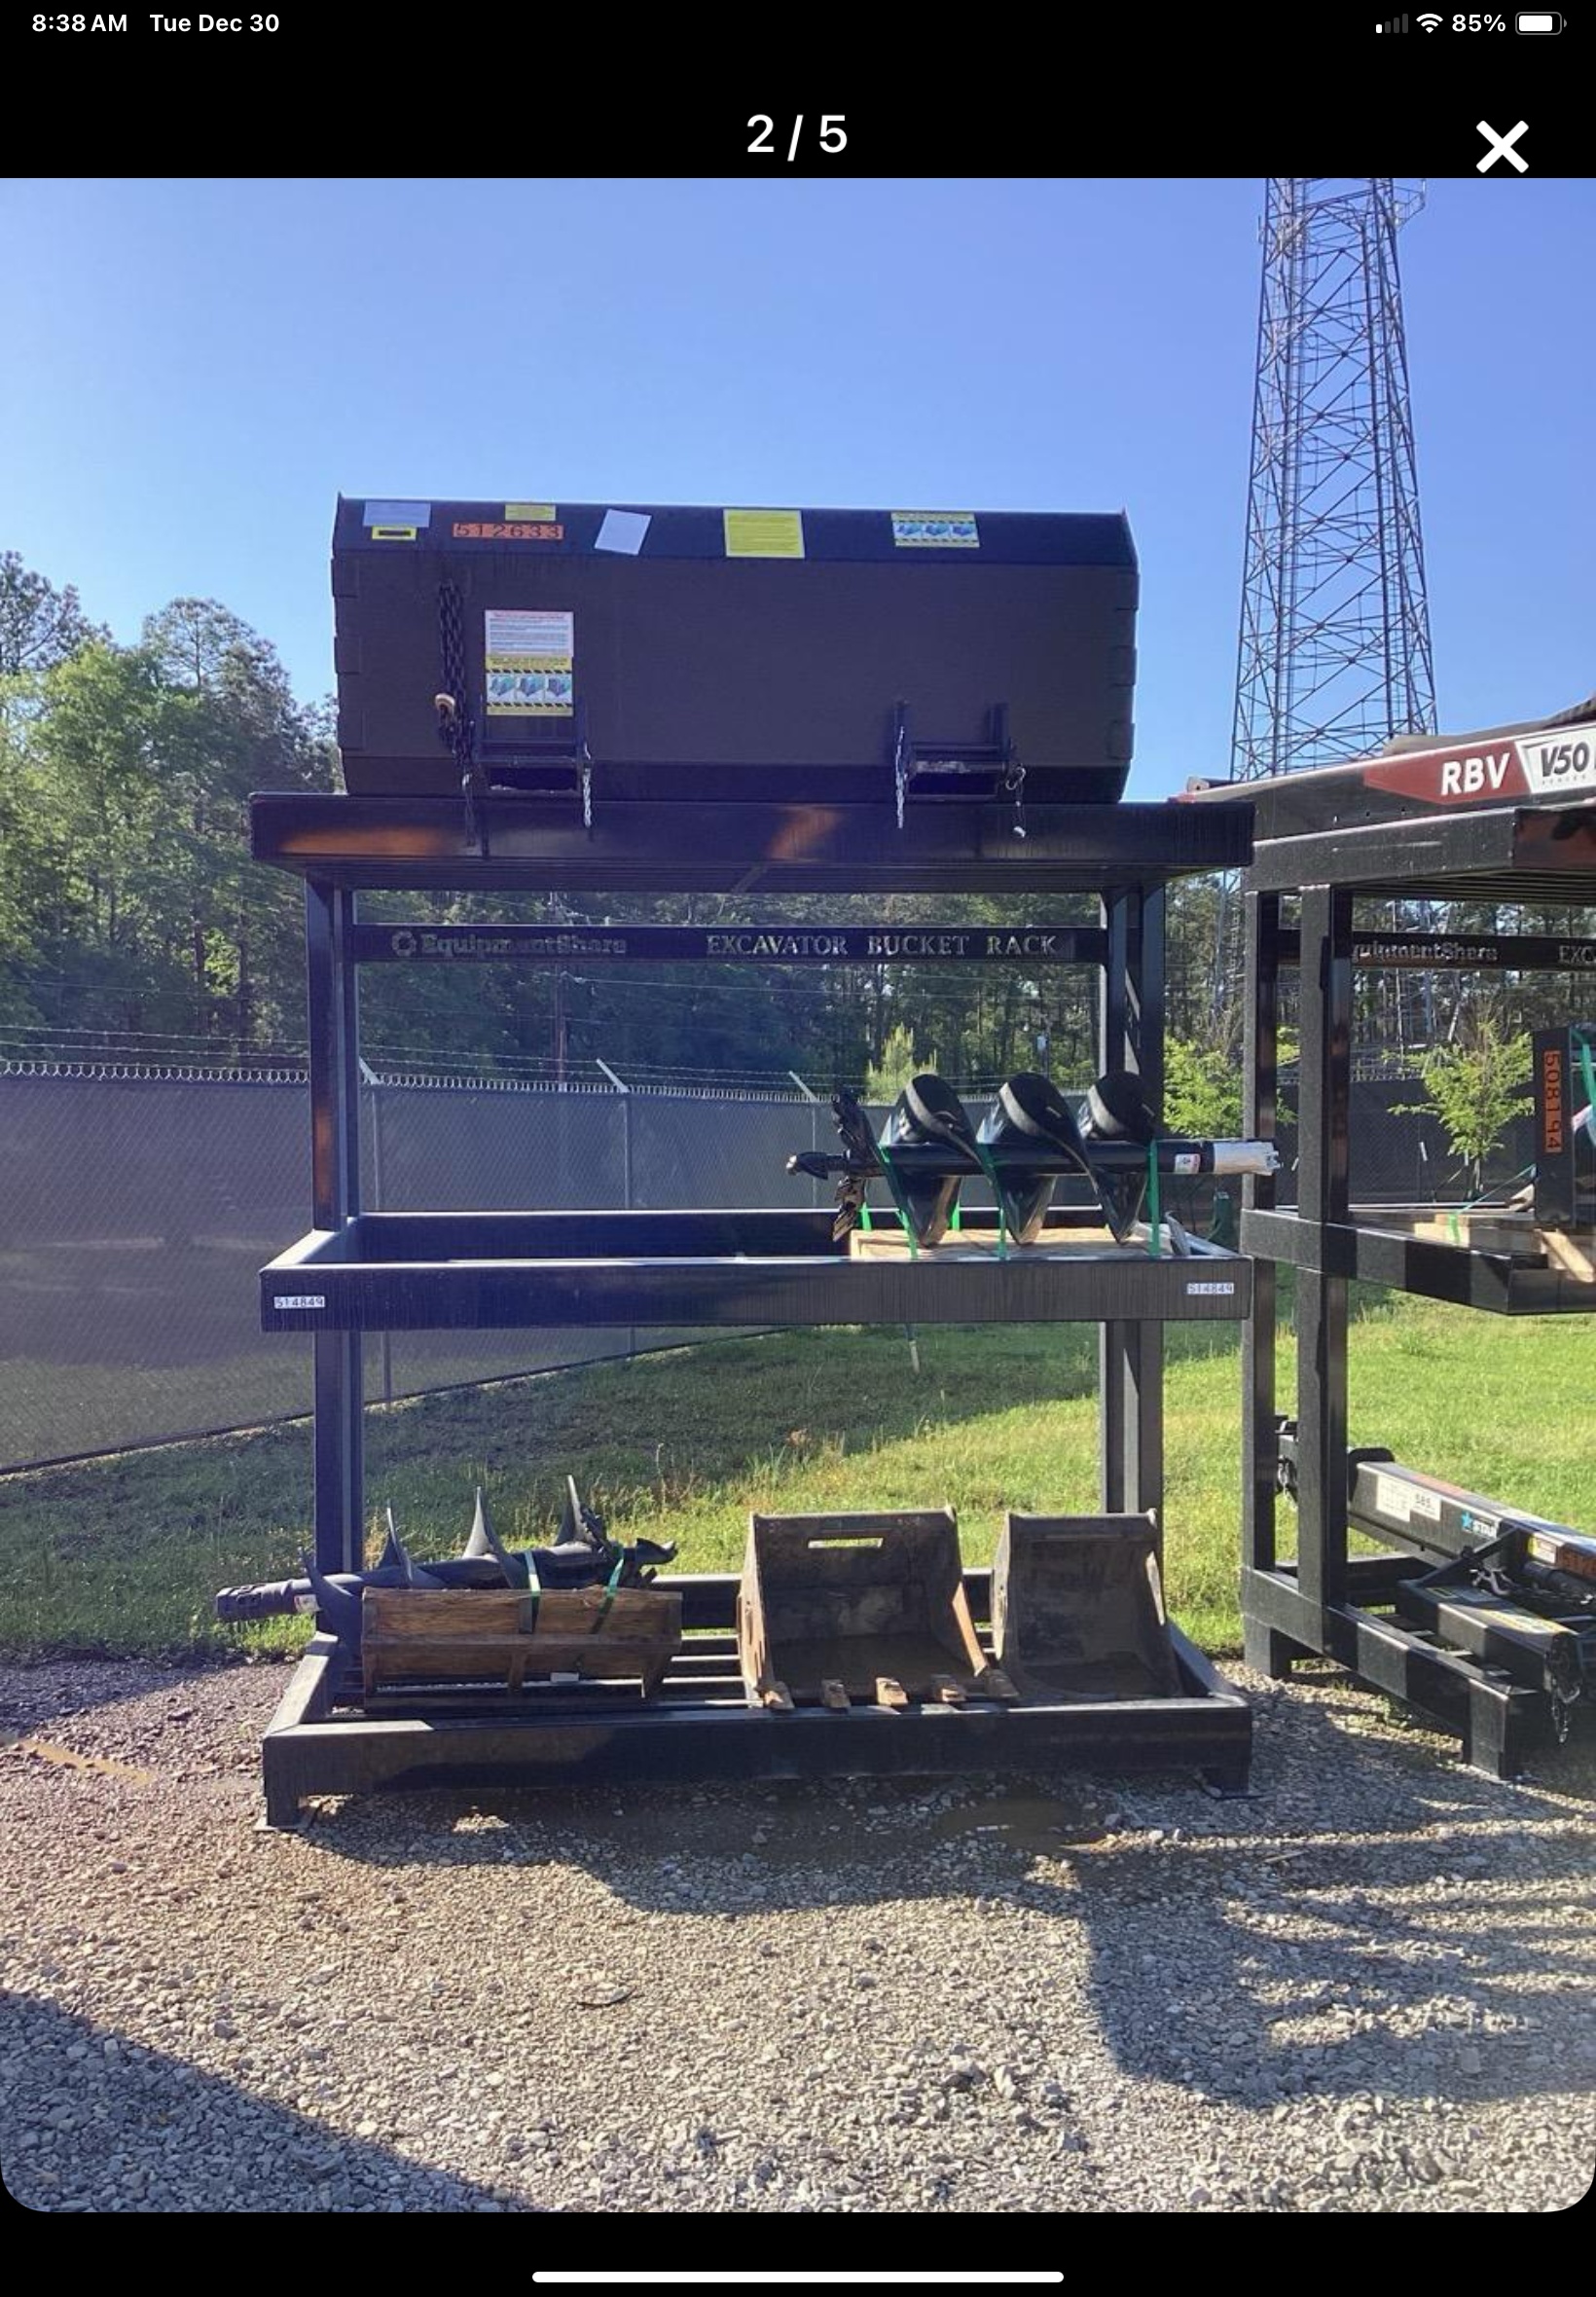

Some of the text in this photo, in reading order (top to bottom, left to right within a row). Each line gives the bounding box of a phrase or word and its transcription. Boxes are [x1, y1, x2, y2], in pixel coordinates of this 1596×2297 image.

[454, 524, 562, 539] 512633
[1440, 741, 1596, 796] RBV V50
[706, 934, 1058, 956] EXCAVATOR BUCKET RACK
